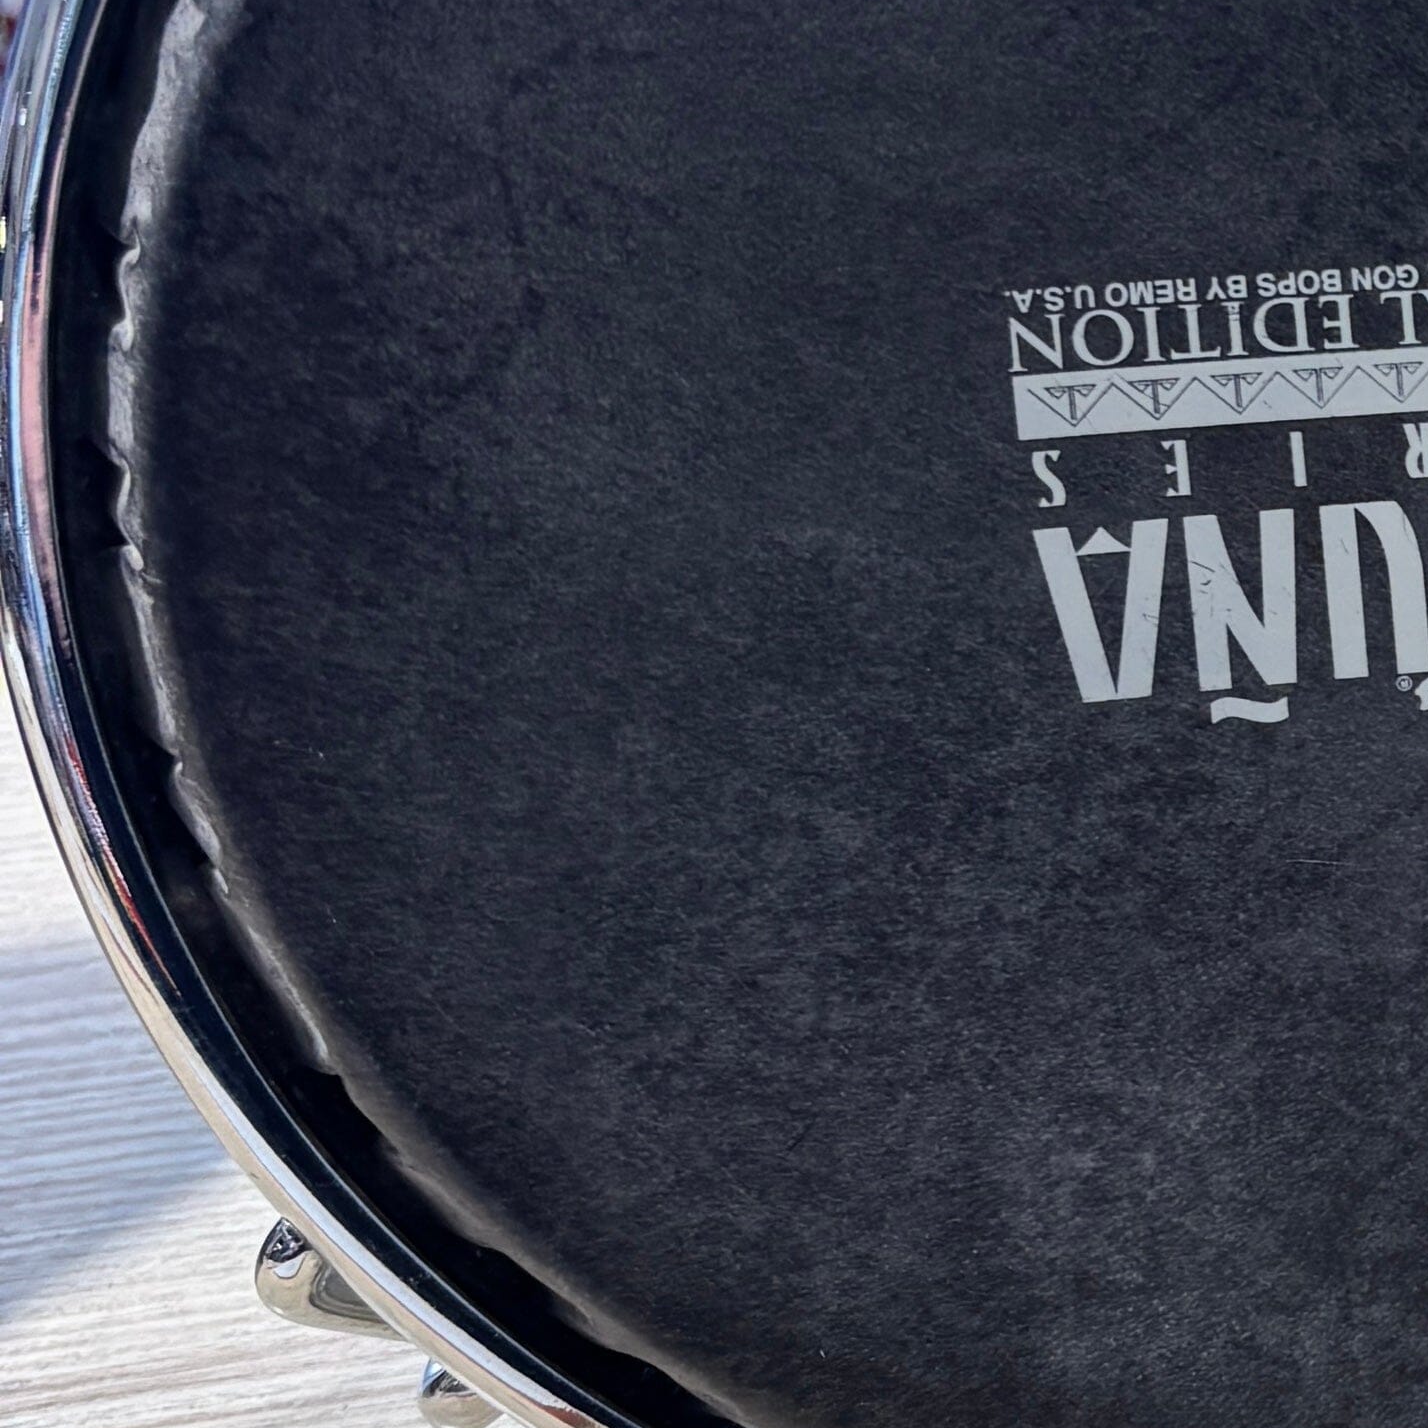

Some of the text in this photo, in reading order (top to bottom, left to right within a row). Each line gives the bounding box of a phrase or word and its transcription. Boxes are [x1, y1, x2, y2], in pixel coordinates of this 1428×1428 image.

[1206, 275, 1248, 300] BY
[1256, 269, 1342, 297] BOPS
[1350, 265, 1419, 291] GON
[1004, 284, 1096, 313] U.S.A.
[1104, 278, 1197, 307] REMO
[1008, 294, 1360, 373] EDITION
